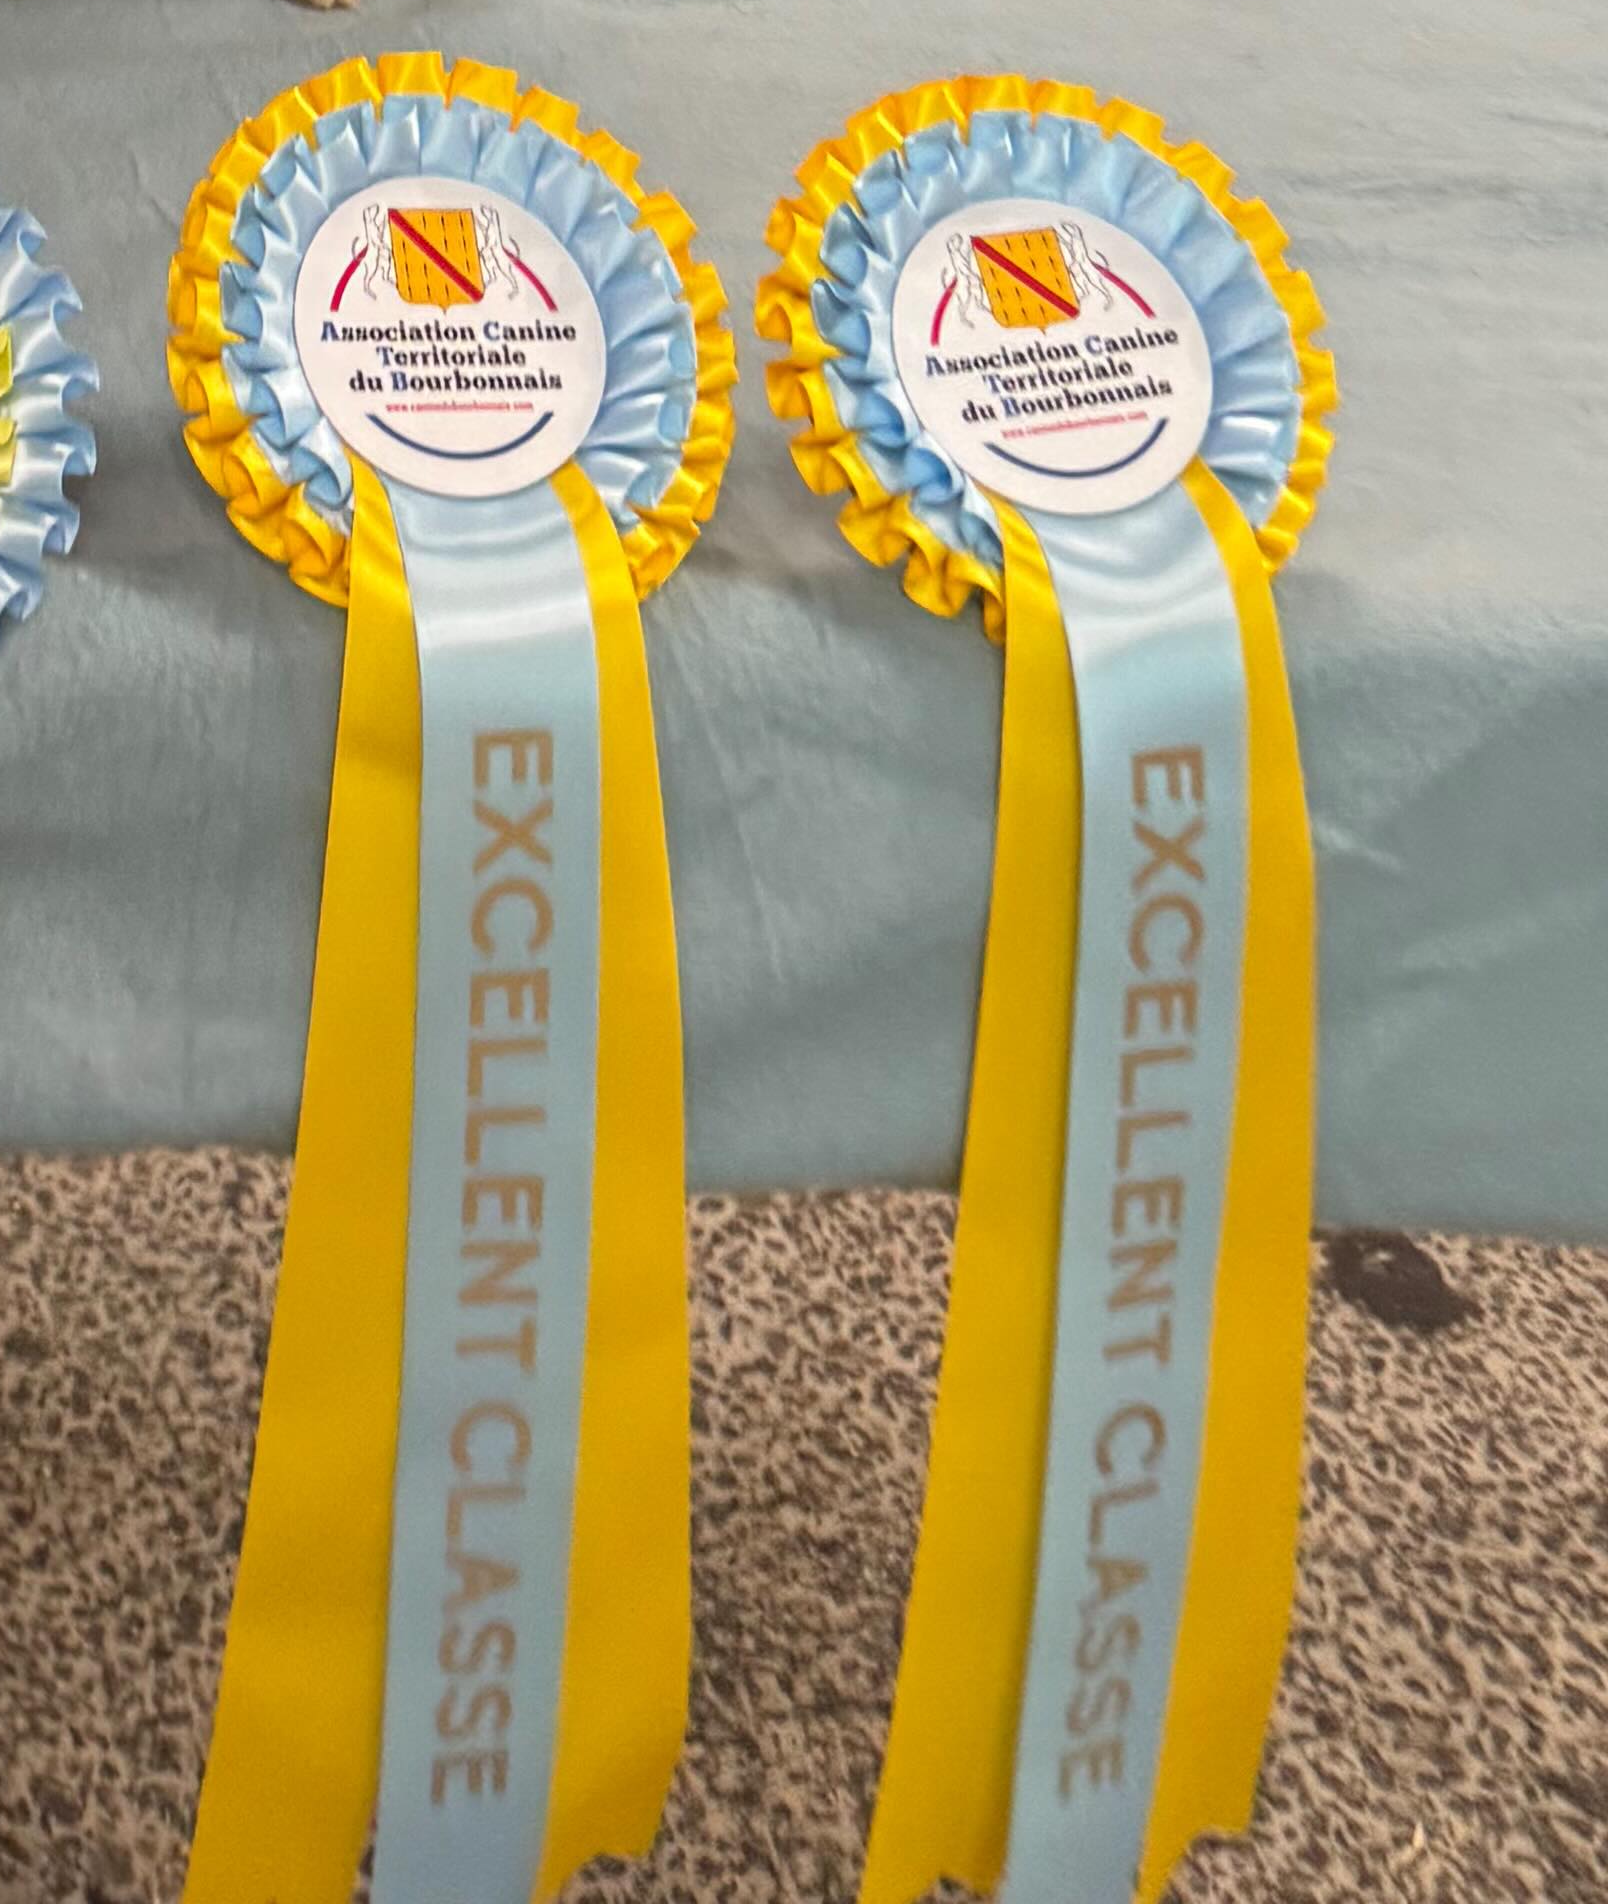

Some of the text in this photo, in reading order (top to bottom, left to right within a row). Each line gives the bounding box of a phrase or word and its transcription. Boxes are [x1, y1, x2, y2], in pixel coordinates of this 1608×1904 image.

[321, 319, 576, 343] Association Canine
[925, 326, 1179, 377] Association Canine
[376, 345, 526, 368] Territoriale
[983, 357, 1134, 395] Territoriale
[349, 368, 562, 393] du Bourbonnais
[961, 375, 1173, 423] du Bourbonnais
[430, 727, 554, 1806] EXCELLENT CLASSE
[1058, 745, 1203, 1801] EXCELLENT CLASSE
